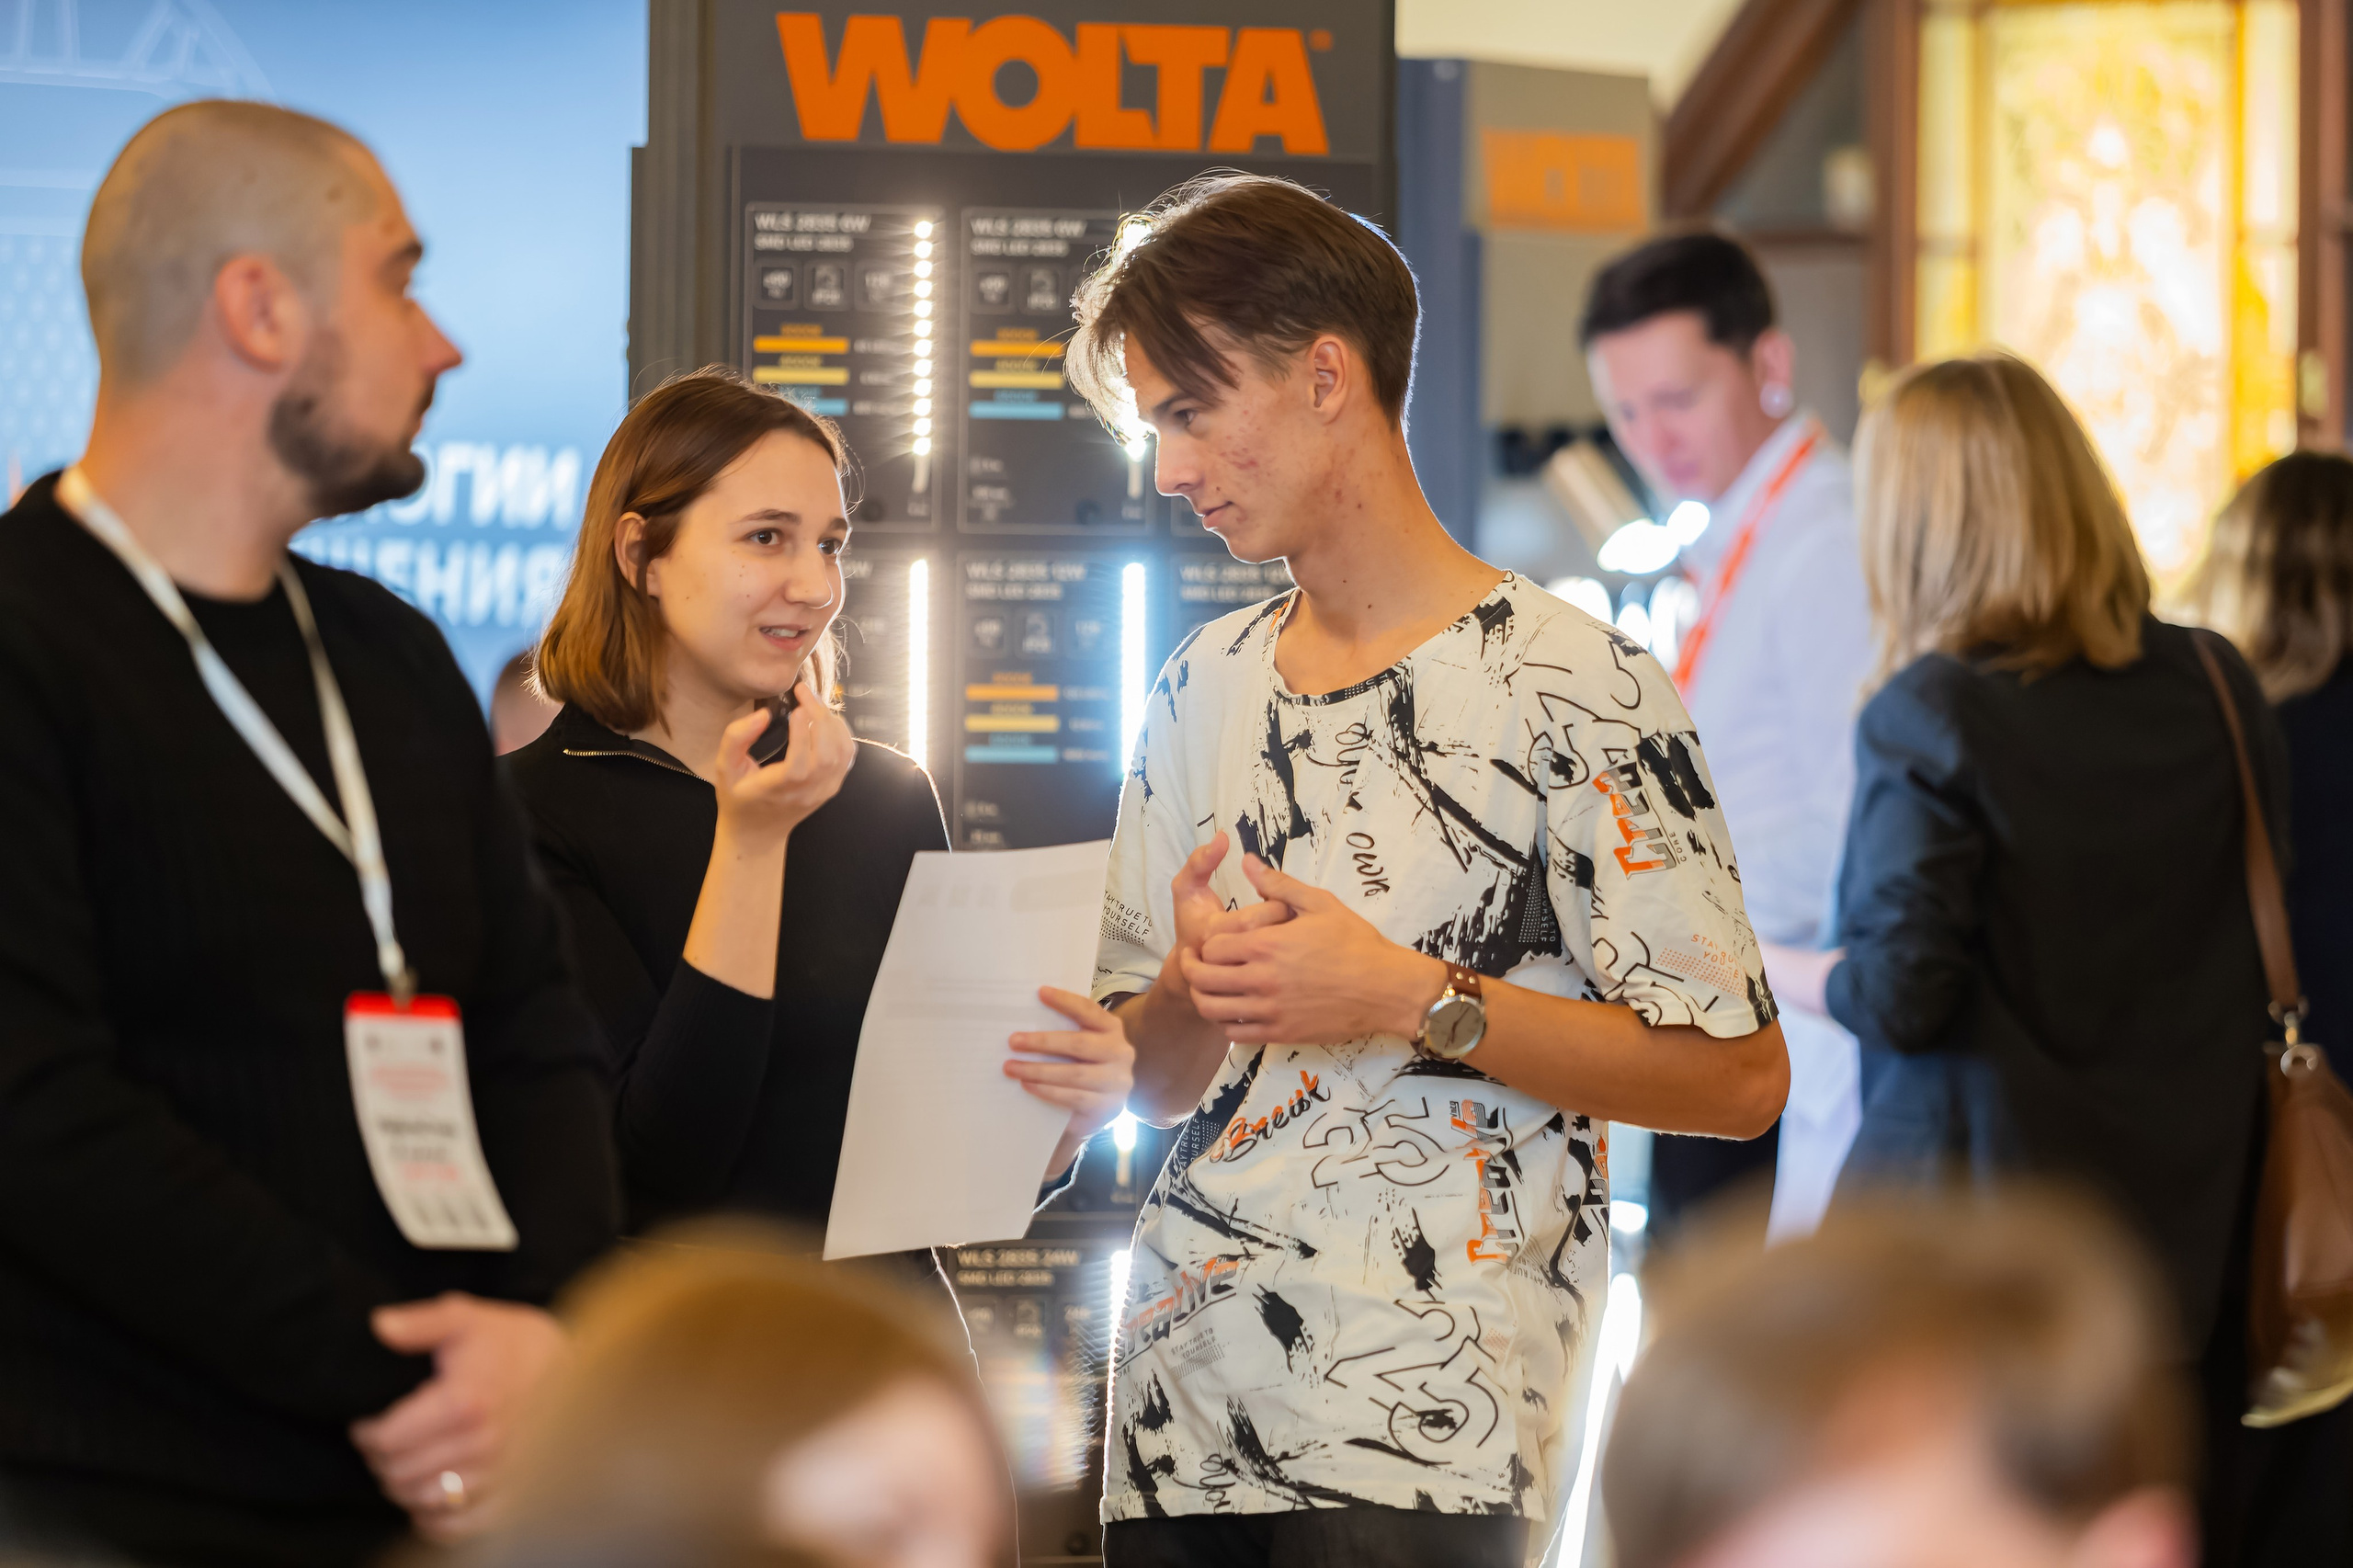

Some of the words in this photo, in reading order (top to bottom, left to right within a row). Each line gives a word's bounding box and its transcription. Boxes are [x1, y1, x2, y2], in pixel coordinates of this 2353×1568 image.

[776, 13, 1329, 154] WOLTA
[1103, 904, 1150, 936] YOURSELF
[1116, 901, 1142, 920] TRUE
[1210, 1070, 1331, 1164] Break
